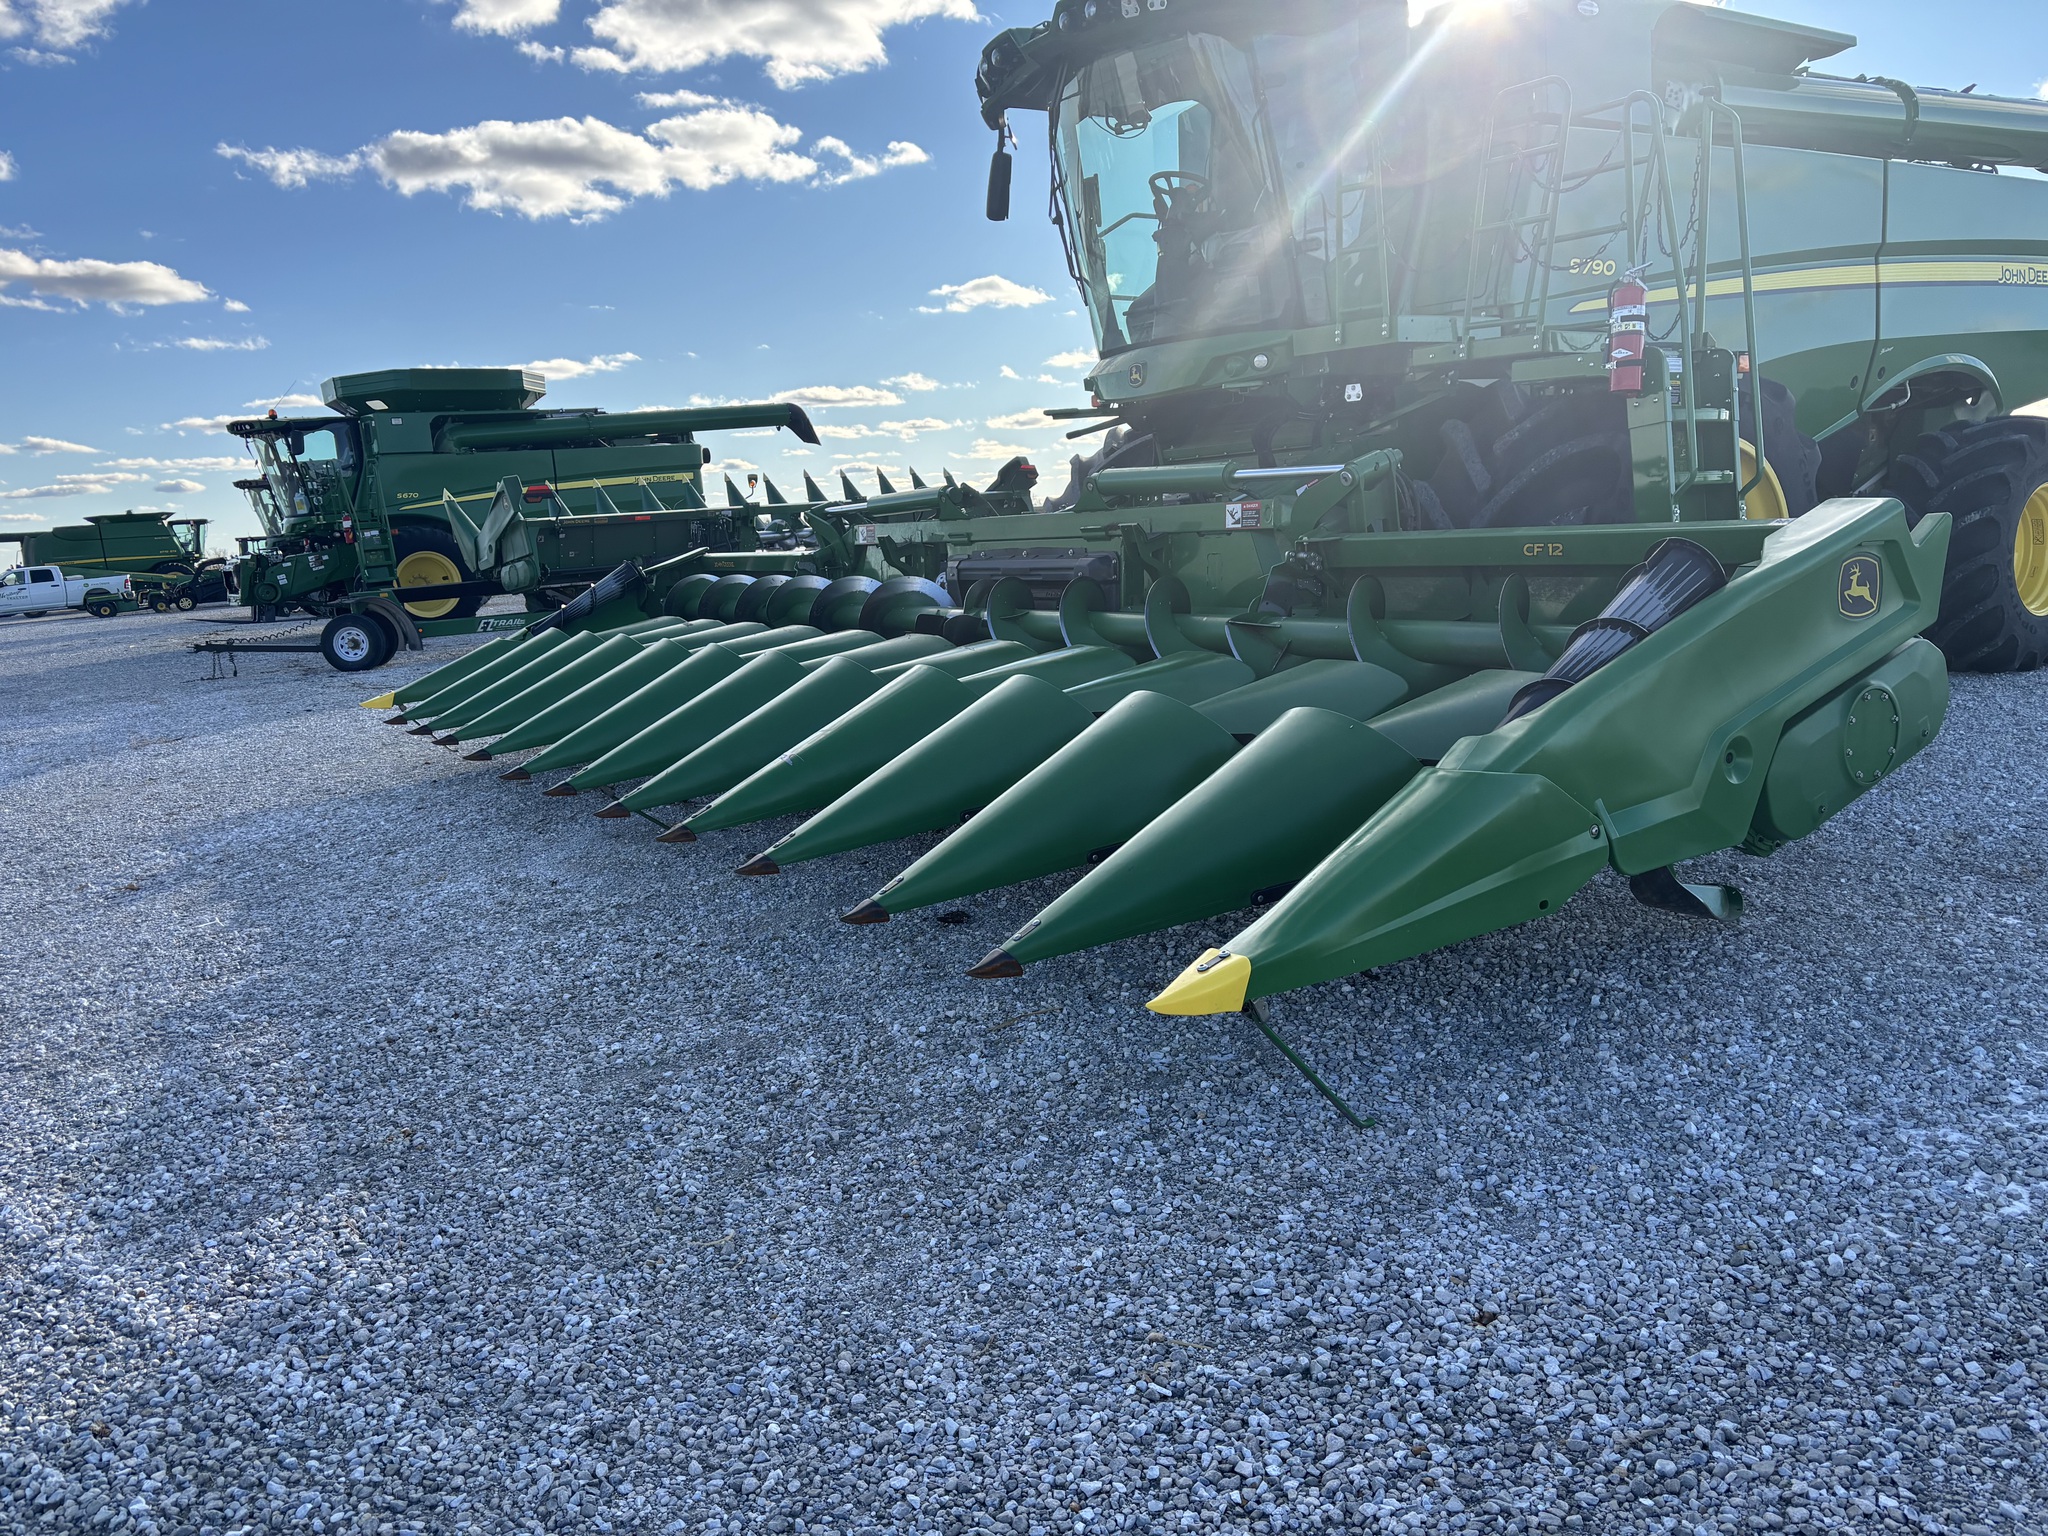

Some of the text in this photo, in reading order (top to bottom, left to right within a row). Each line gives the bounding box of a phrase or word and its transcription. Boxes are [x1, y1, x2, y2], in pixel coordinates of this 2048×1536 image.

[1569, 258, 1616, 276] S790
[1998, 265, 2026, 282] JOHN
[1523, 543, 1563, 556] CF 12
[493, 618, 520, 627] TRAIL
